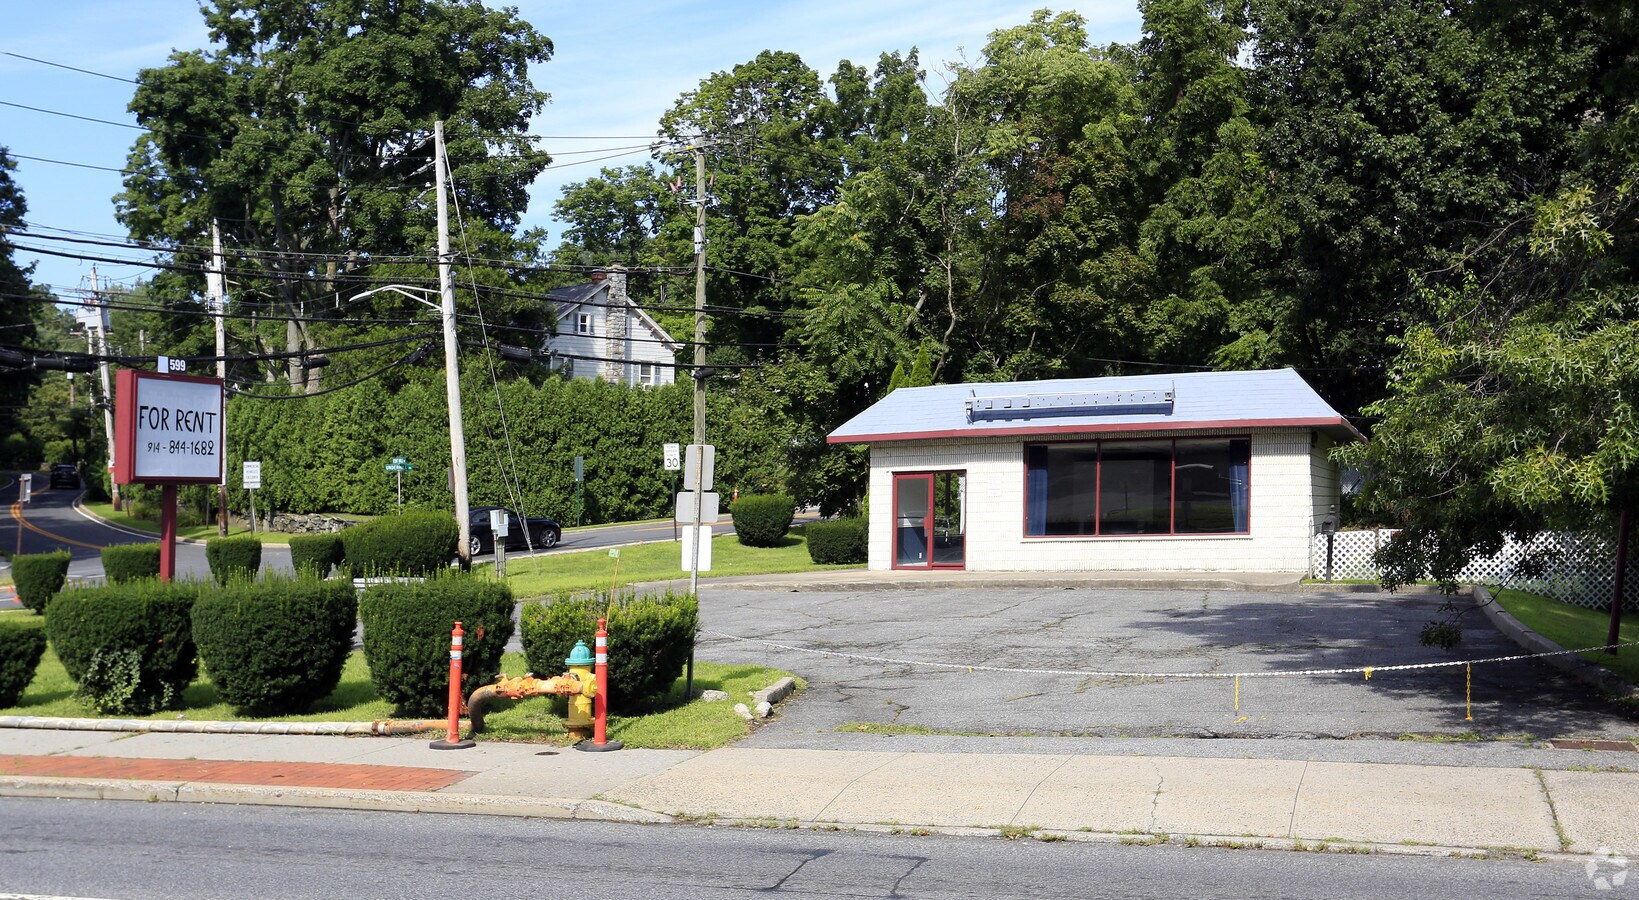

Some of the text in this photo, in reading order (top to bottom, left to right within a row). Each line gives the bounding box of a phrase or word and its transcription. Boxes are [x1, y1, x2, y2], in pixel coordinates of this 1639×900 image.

[169, 359, 186, 372] 599
[139, 406, 217, 433] FOR RENT
[147, 442, 160, 453] 914
[666, 457, 679, 468] 30
